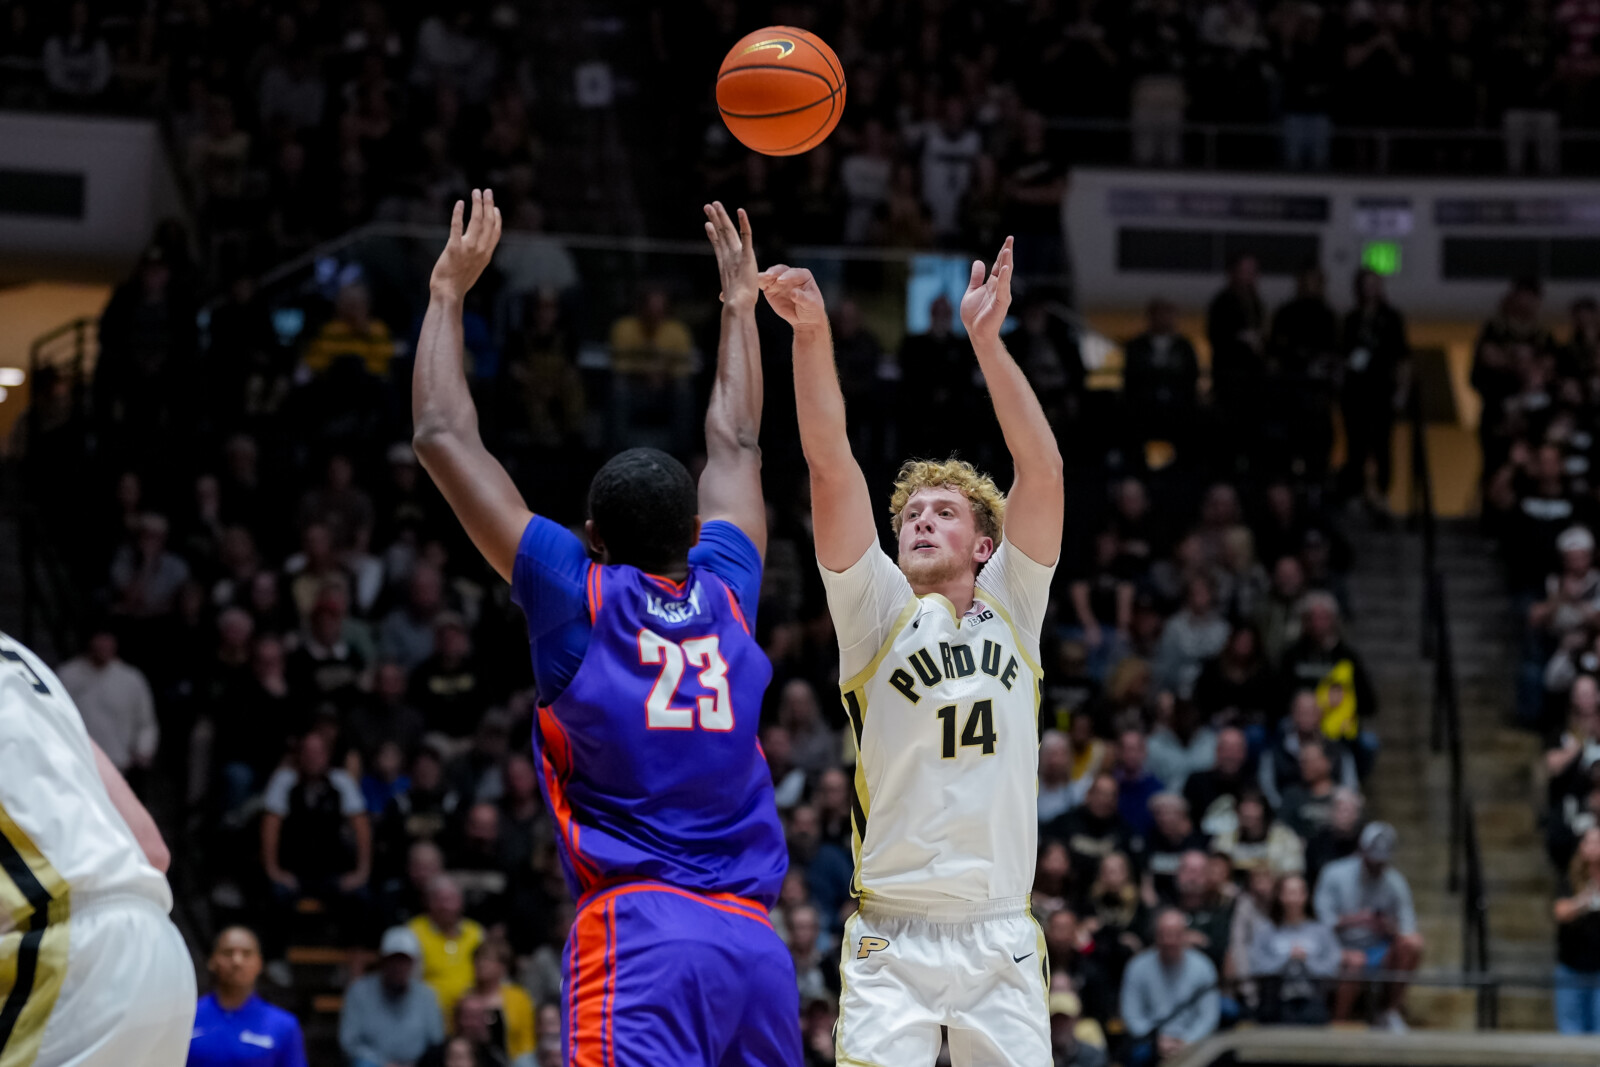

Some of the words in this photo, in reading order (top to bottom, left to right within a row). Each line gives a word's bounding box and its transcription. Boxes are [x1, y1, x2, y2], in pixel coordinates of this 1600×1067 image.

[636, 628, 735, 733] 23
[888, 638, 1019, 706] PURDUE
[935, 698, 998, 760] 14
[856, 935, 890, 960] P
